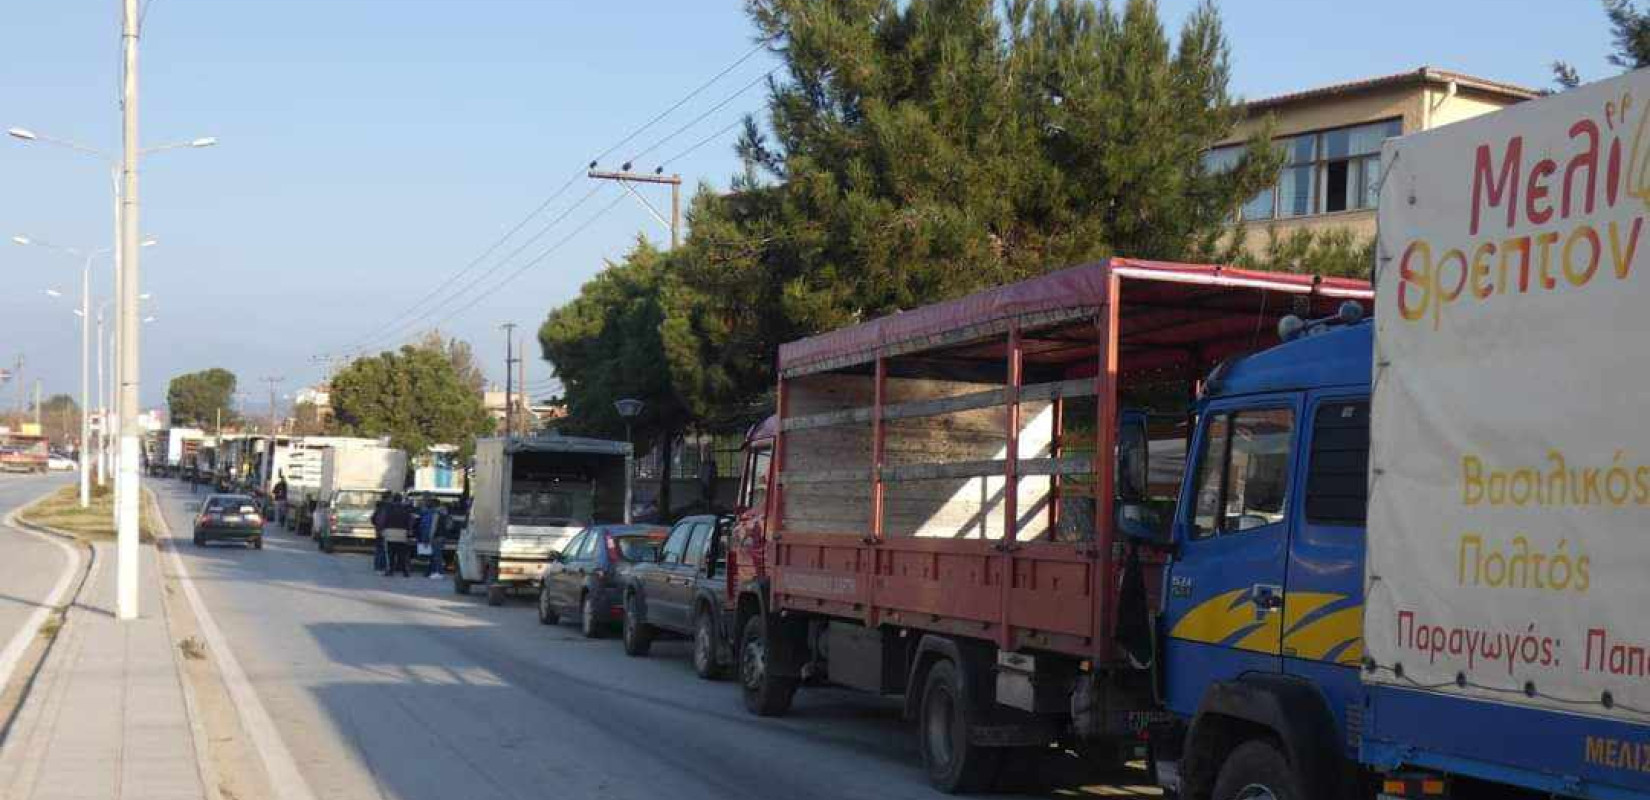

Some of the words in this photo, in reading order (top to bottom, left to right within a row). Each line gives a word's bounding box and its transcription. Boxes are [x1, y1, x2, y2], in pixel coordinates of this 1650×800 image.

[1461, 449, 1650, 506] Βασιλικός
[1458, 535, 1590, 592] Πολτός
[1397, 611, 1560, 676] Παραγωγός:
[1584, 628, 1650, 678] Παπ
